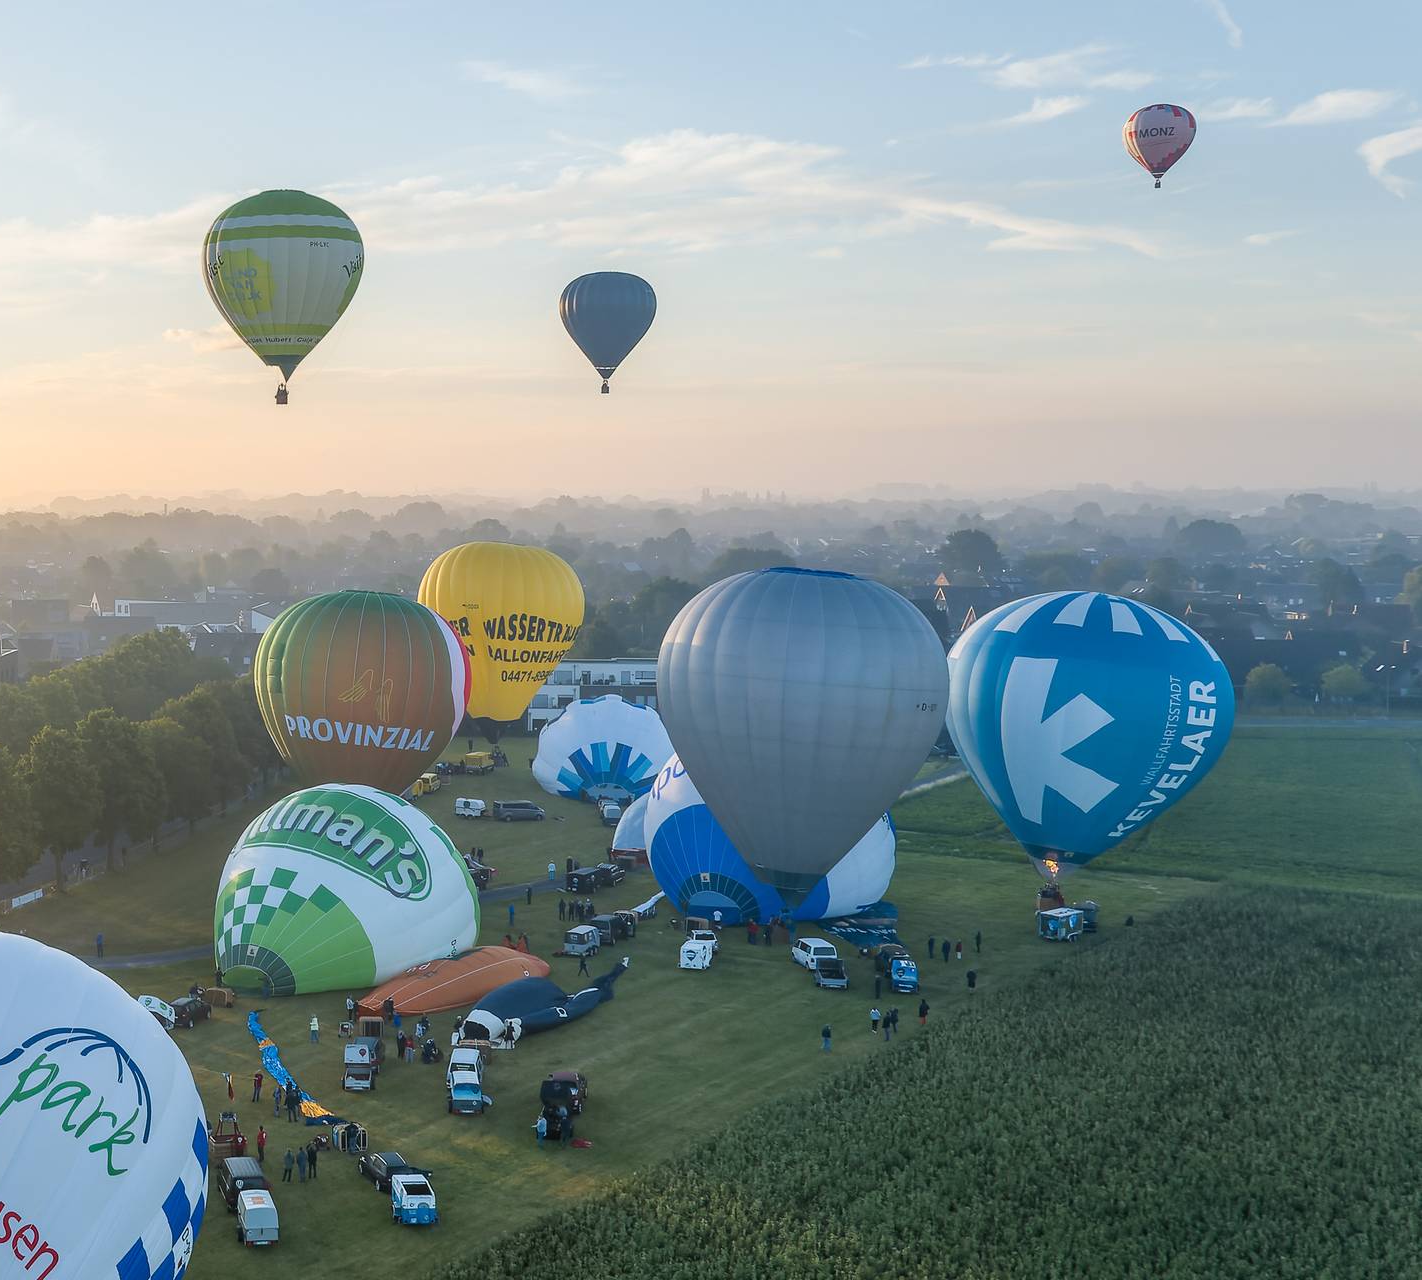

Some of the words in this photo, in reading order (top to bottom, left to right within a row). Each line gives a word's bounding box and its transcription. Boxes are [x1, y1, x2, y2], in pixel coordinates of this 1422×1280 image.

[284, 714, 435, 752] PROVINZIAL
[1107, 680, 1217, 838] KEVELAER
[1140, 675, 1183, 786] WALLFAHRTSSTADT
